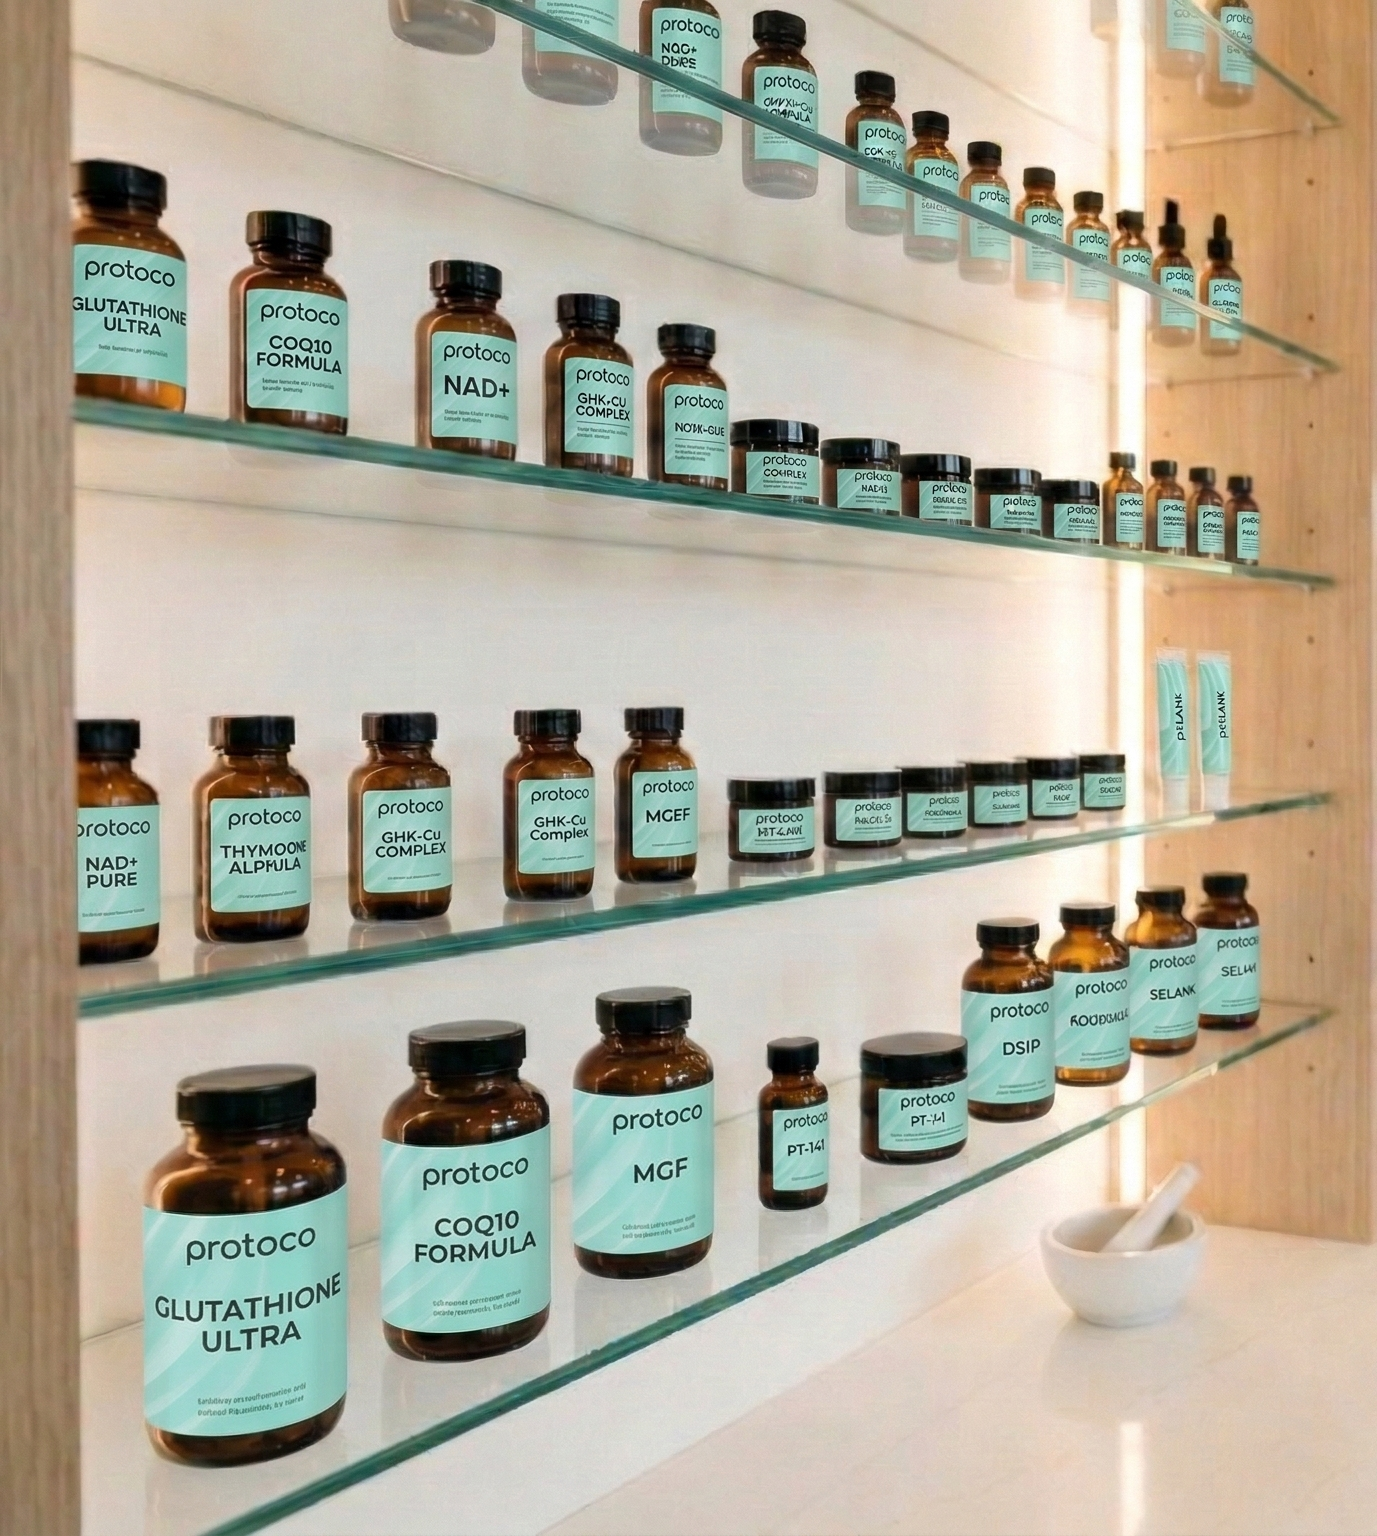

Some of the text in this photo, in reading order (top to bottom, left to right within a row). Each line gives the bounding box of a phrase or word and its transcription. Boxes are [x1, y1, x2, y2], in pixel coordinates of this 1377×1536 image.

[660, 18, 720, 39] protoco
[763, 75, 815, 94] protoco
[84, 259, 176, 287] protoco
[72, 296, 187, 327] GLUTATHIONE
[260, 302, 340, 326] protoco
[103, 316, 162, 338] ULTRA
[269, 335, 332, 354] COQ10
[443, 342, 511, 365] protoco
[256, 352, 342, 374] FORMULA
[444, 375, 510, 398] NAD+
[576, 368, 630, 387] protoco
[674, 393, 724, 411] protoco
[575, 405, 631, 422] COMPLEX
[763, 454, 807, 467] protoco
[530, 786, 590, 805] protoco
[642, 778, 695, 797] protoco
[378, 798, 444, 819] protoco
[646, 807, 691, 824] MGEF
[228, 808, 302, 830] protoco
[533, 814, 587, 829] GHK-Cu
[755, 812, 804, 826] protoco
[381, 829, 441, 845] GHK-Cu
[529, 826, 589, 843] Complex
[219, 840, 307, 859] THYMOONE
[375, 841, 447, 859] COMPLEX
[86, 856, 138, 872] NAD+
[86, 871, 138, 889] PURE
[1149, 954, 1196, 972] protoco
[1075, 979, 1128, 999] protoco
[1149, 983, 1197, 1001] SELANK
[990, 1001, 1050, 1022] protoco
[1002, 1038, 1041, 1056] DSIP
[900, 1091, 956, 1111] protoco
[612, 1103, 703, 1135] protoco
[783, 1111, 828, 1132] protoco
[787, 1138, 825, 1157] PT-141
[422, 1157, 529, 1191] protoco
[633, 1157, 689, 1184] MGF
[434, 1210, 520, 1239] COQ10
[186, 1227, 316, 1266] protoco
[414, 1231, 537, 1264] FORMULA
[155, 1271, 341, 1323] GLUTATHIONE
[201, 1320, 302, 1353] ULTRA
